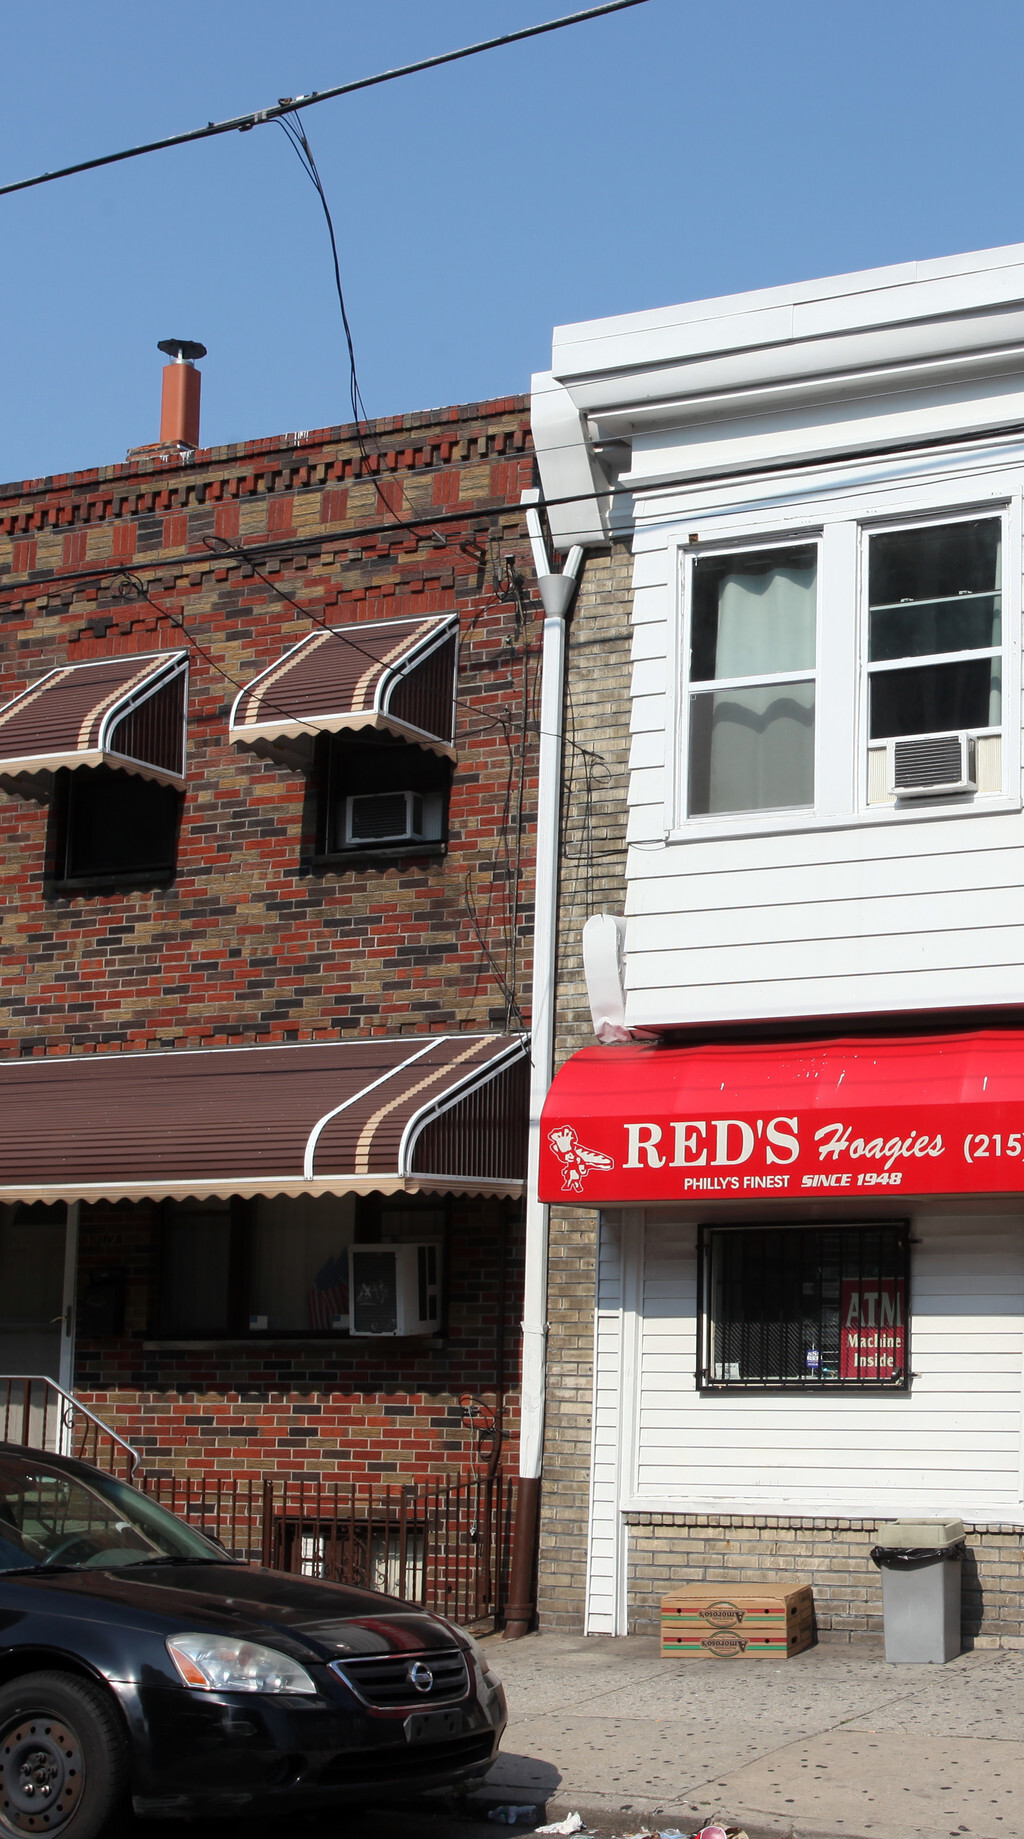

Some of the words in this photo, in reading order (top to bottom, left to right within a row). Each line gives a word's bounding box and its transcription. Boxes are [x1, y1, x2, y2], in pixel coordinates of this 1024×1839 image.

[622, 1116, 800, 1169] RED'S
[814, 1122, 945, 1170] Hoagies
[684, 1176, 740, 1190] PHILLY'S
[743, 1175, 790, 1188] FINEST
[801, 1173, 853, 1187] SINCE
[856, 1172, 903, 1186] 1948
[845, 1292, 902, 1327] ATM
[847, 1333, 902, 1348] Machine
[854, 1353, 894, 1367] Inside
[699, 1611, 745, 1623] Amoroso's
